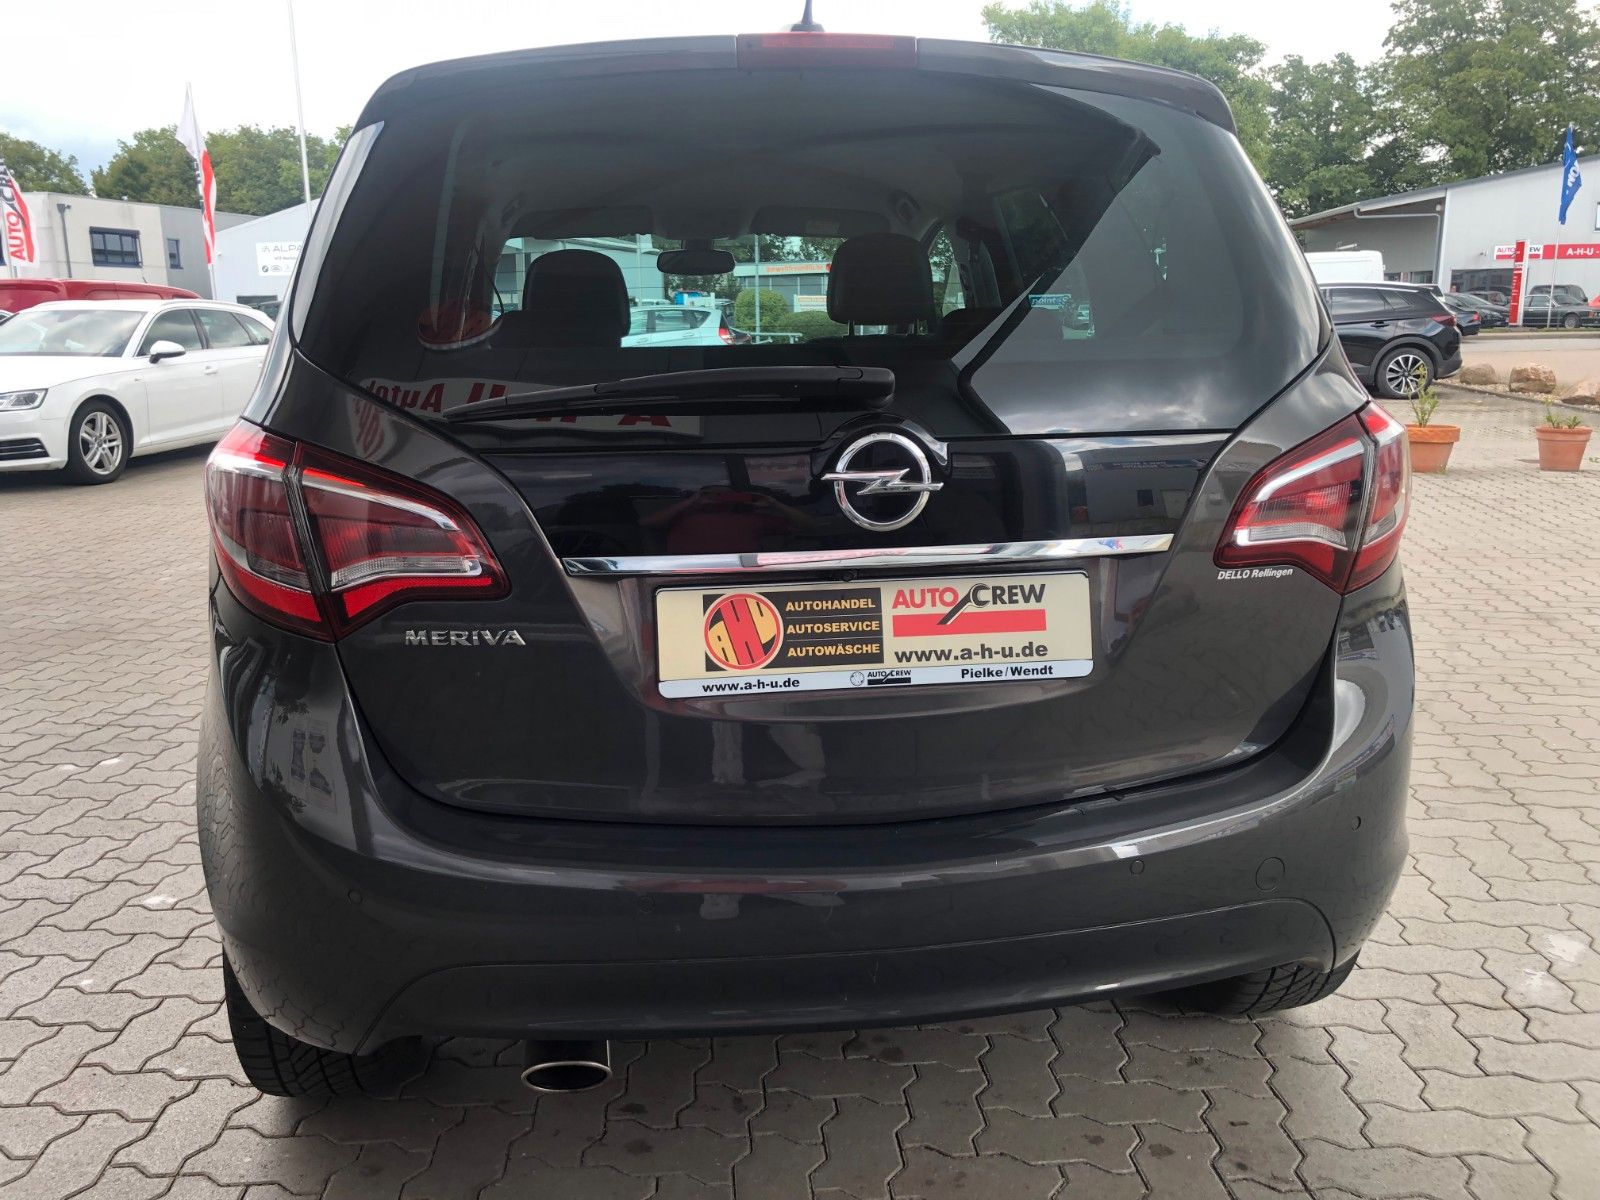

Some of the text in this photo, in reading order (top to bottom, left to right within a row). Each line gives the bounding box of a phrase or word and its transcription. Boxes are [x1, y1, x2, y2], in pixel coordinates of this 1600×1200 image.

[6, 211, 26, 260] AUTO
[1566, 247, 1594, 256] A-H-U
[1217, 568, 1293, 580] DELLO Rellingen
[892, 583, 1046, 609] AUTO CREW
[785, 598, 876, 612] AUTOHANDEL
[786, 620, 881, 635] AUTOSERVICE
[405, 629, 526, 646] MERIVA
[787, 642, 881, 657] AUTOWÄSCHE
[894, 641, 1049, 664] www.a-h-u.de
[890, 669, 912, 677] CREW
[702, 678, 800, 694] www.a-h-u.de
